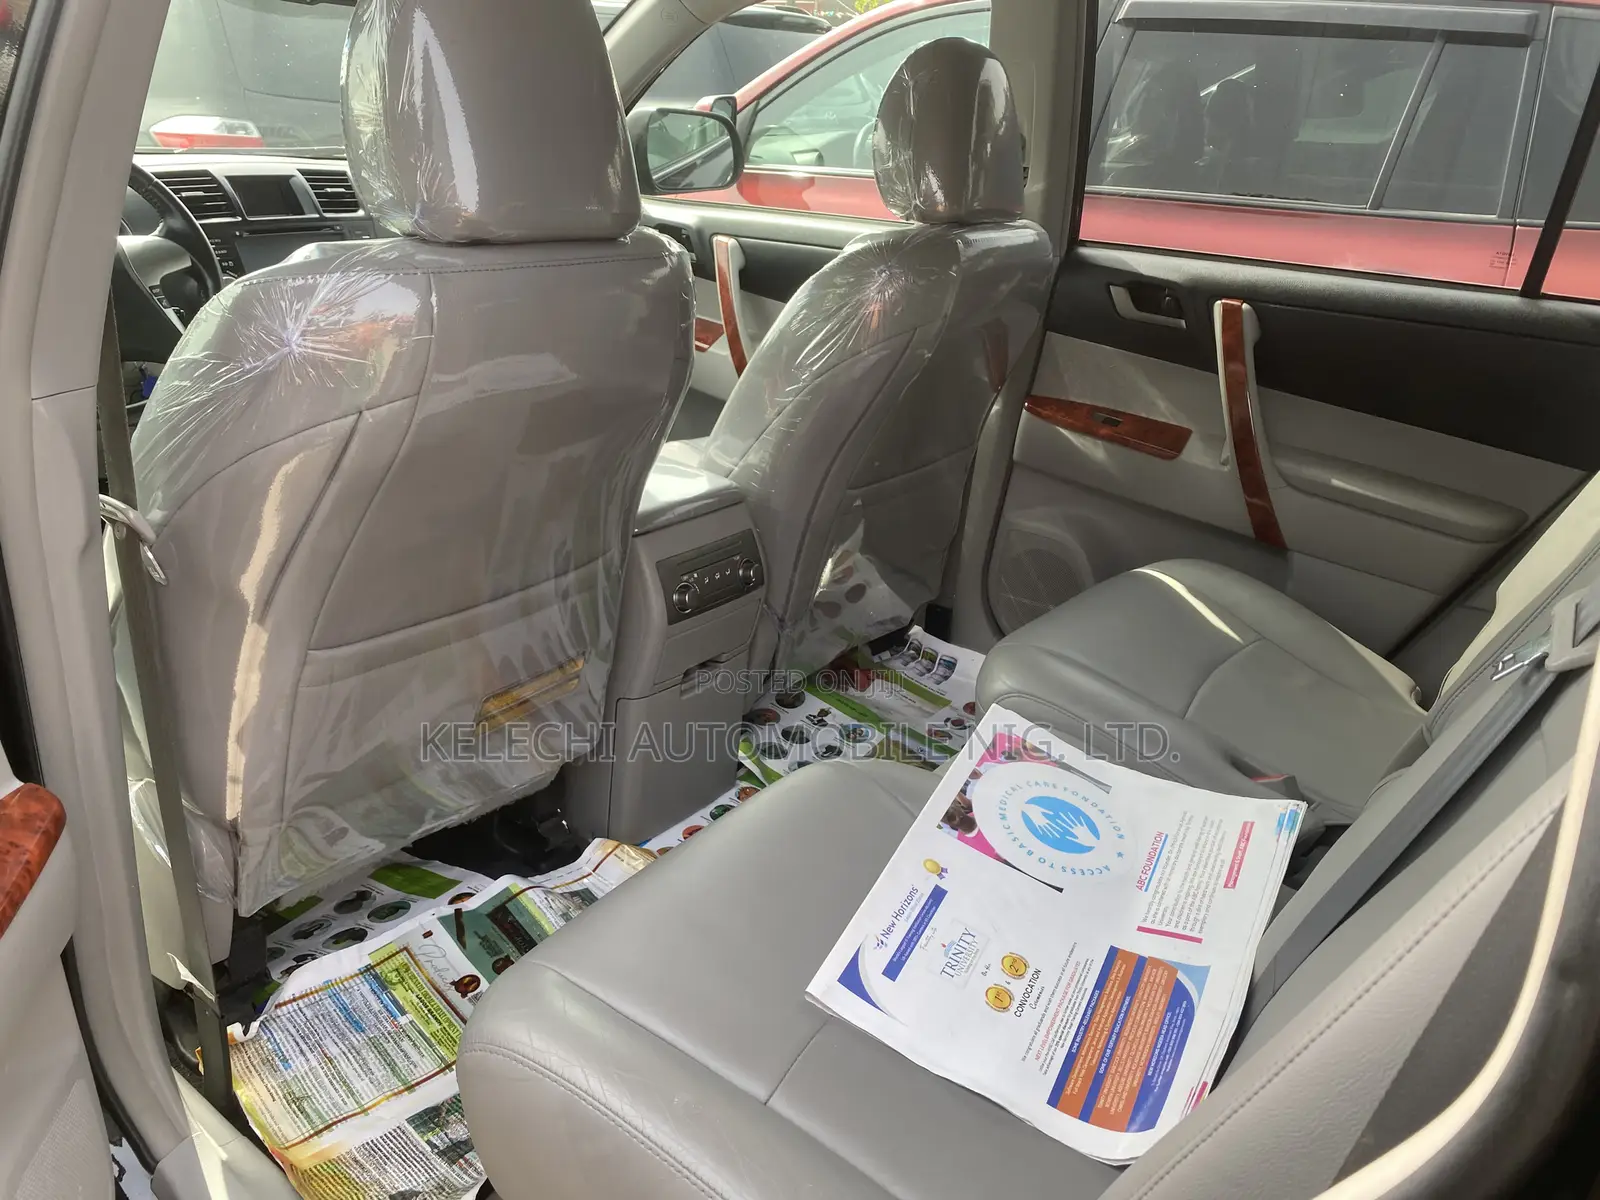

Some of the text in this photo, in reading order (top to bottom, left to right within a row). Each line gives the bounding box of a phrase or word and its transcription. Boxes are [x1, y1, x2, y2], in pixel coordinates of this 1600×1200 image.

[1026, 780, 1058, 789] CARE
[998, 785, 1023, 821] MEDICAL
[1003, 824, 1034, 856] BASIC
[1038, 857, 1055, 869] TO
[1061, 865, 1111, 876] ACCESS
[1136, 831, 1164, 891] ABC FOUNDATION
[882, 886, 918, 939] New Horizons
[941, 927, 976, 979] TRINITY
[955, 938, 978, 977] UNIVERSITY
[1009, 957, 1022, 972] 2nd
[1014, 968, 1041, 1018] CONVOCATION
[1098, 1062, 1106, 1073] SOME
